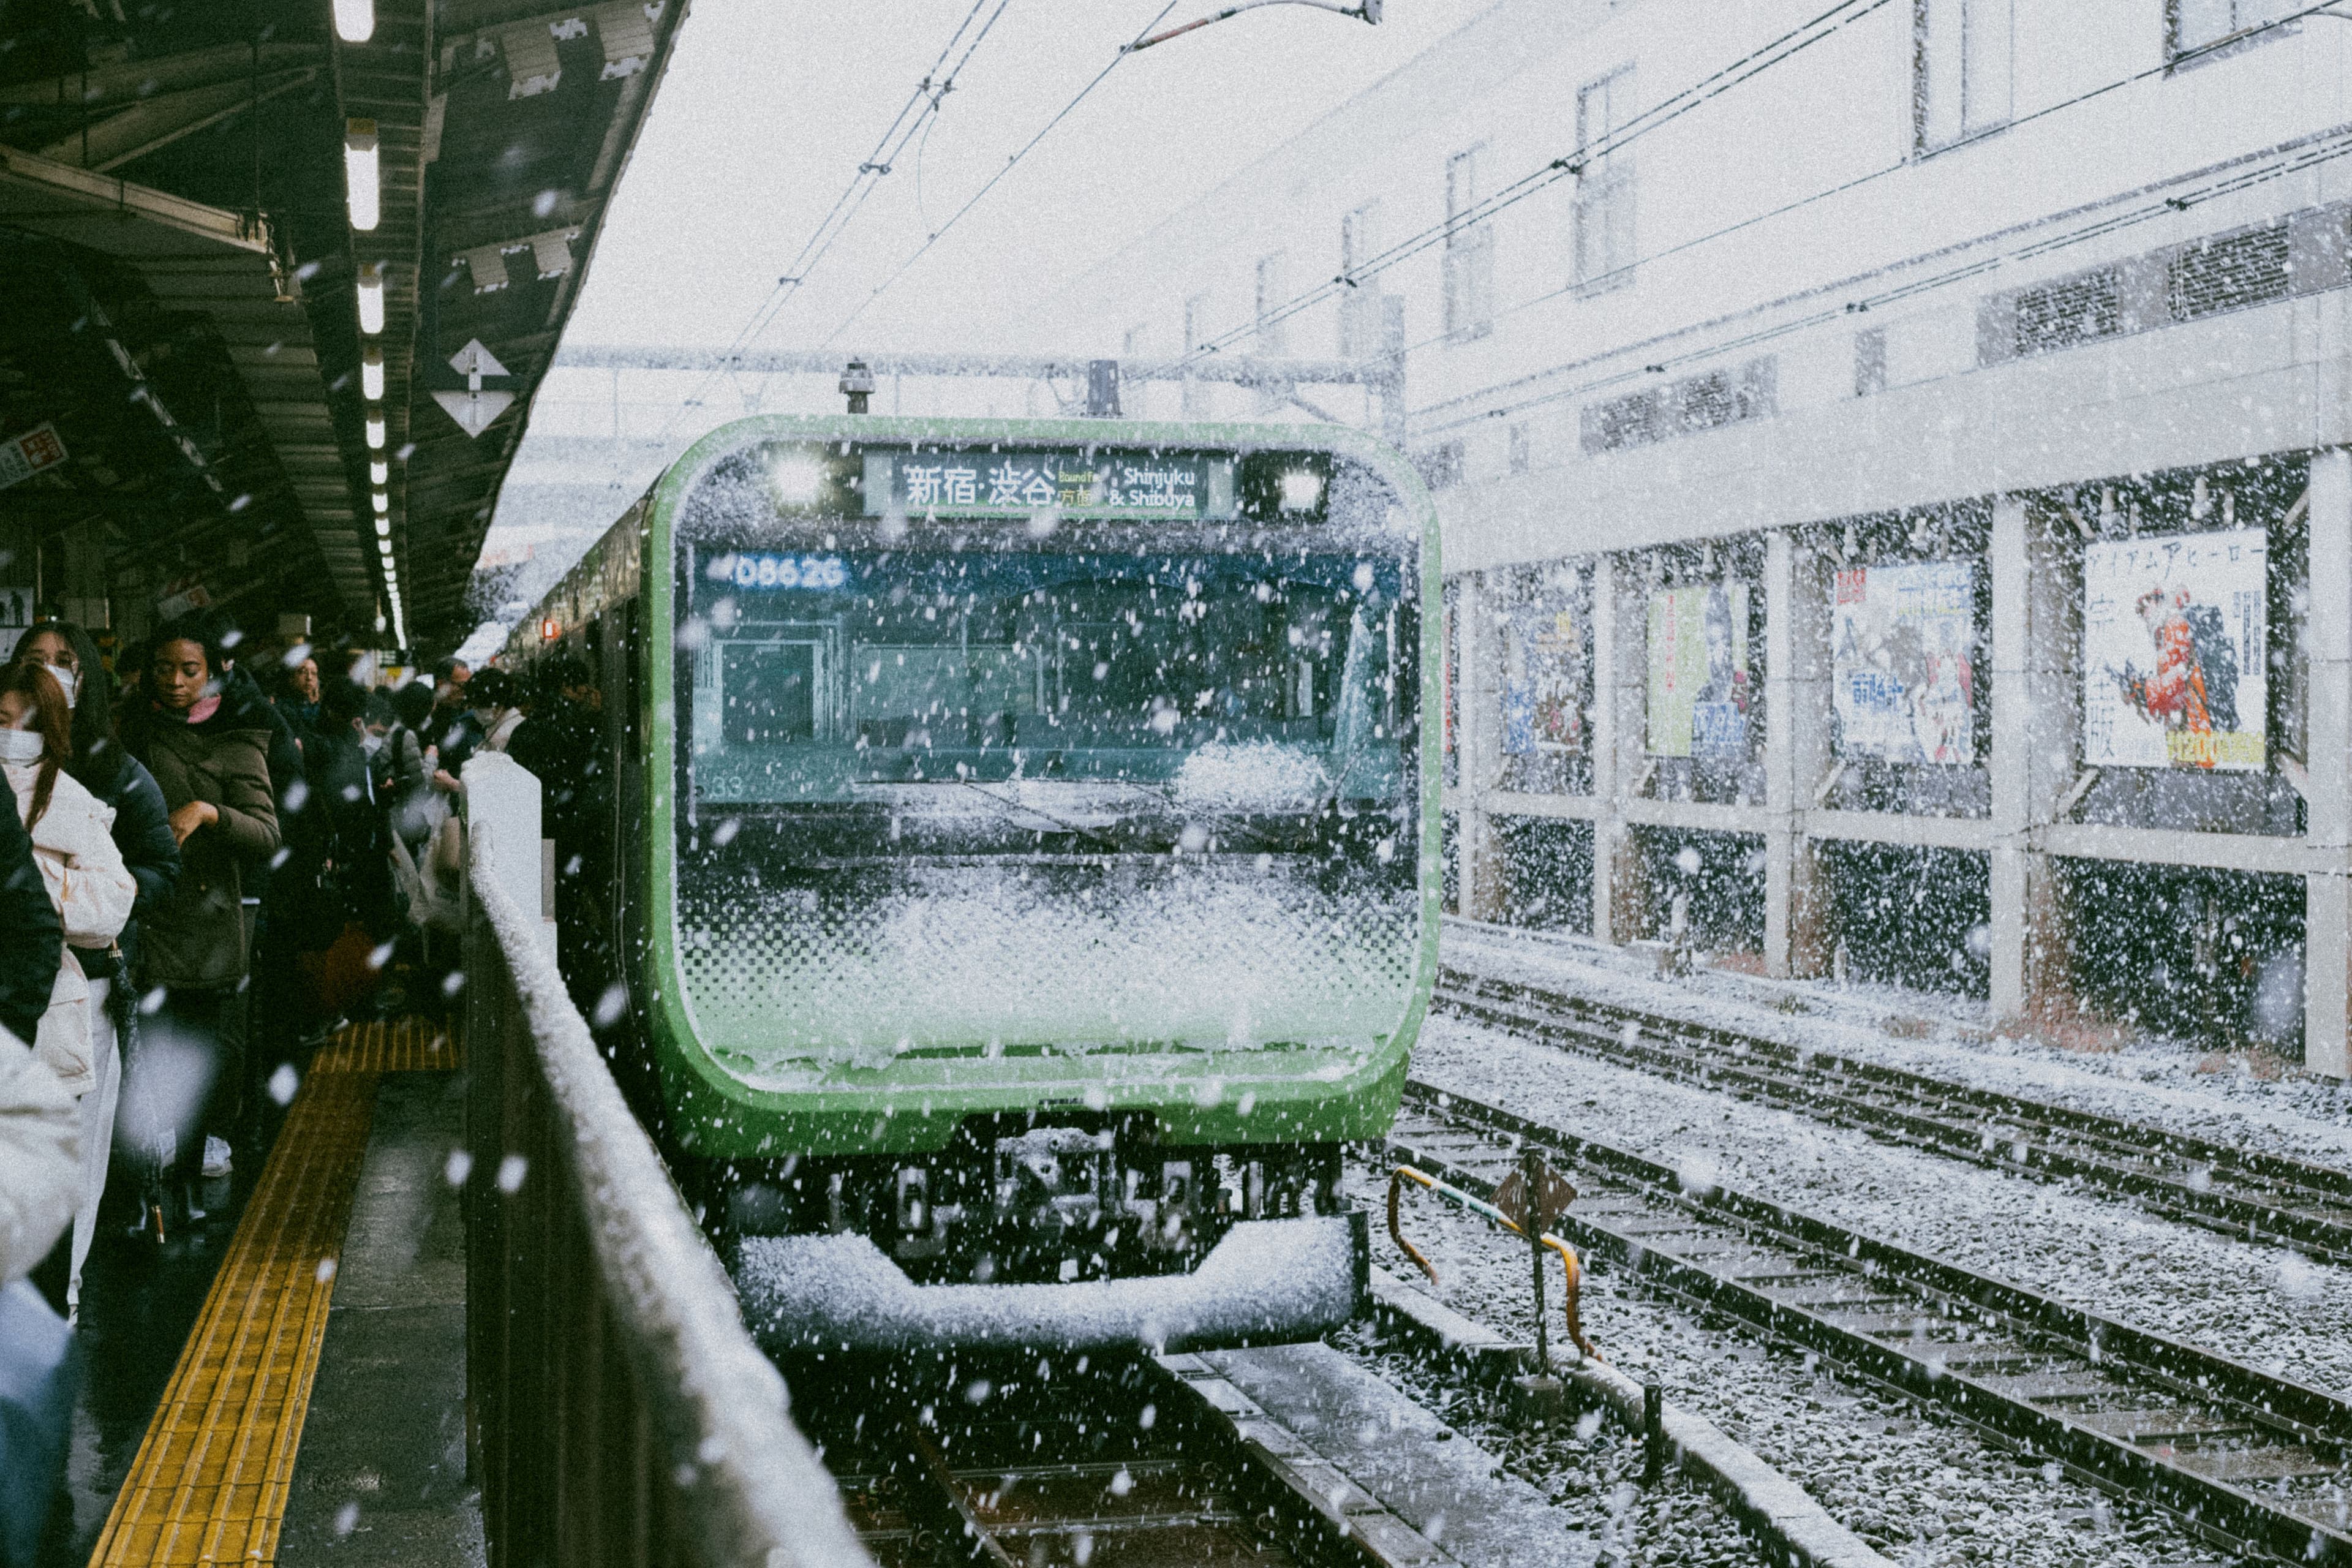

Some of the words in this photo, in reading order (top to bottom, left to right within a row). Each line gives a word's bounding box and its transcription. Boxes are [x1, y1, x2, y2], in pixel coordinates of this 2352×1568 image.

[907, 466, 1057, 505] 新宿・渋谷
[1124, 467, 1195, 489] Shinjuku
[1109, 489, 1125, 507] &
[1130, 489, 1195, 511] Shibuya
